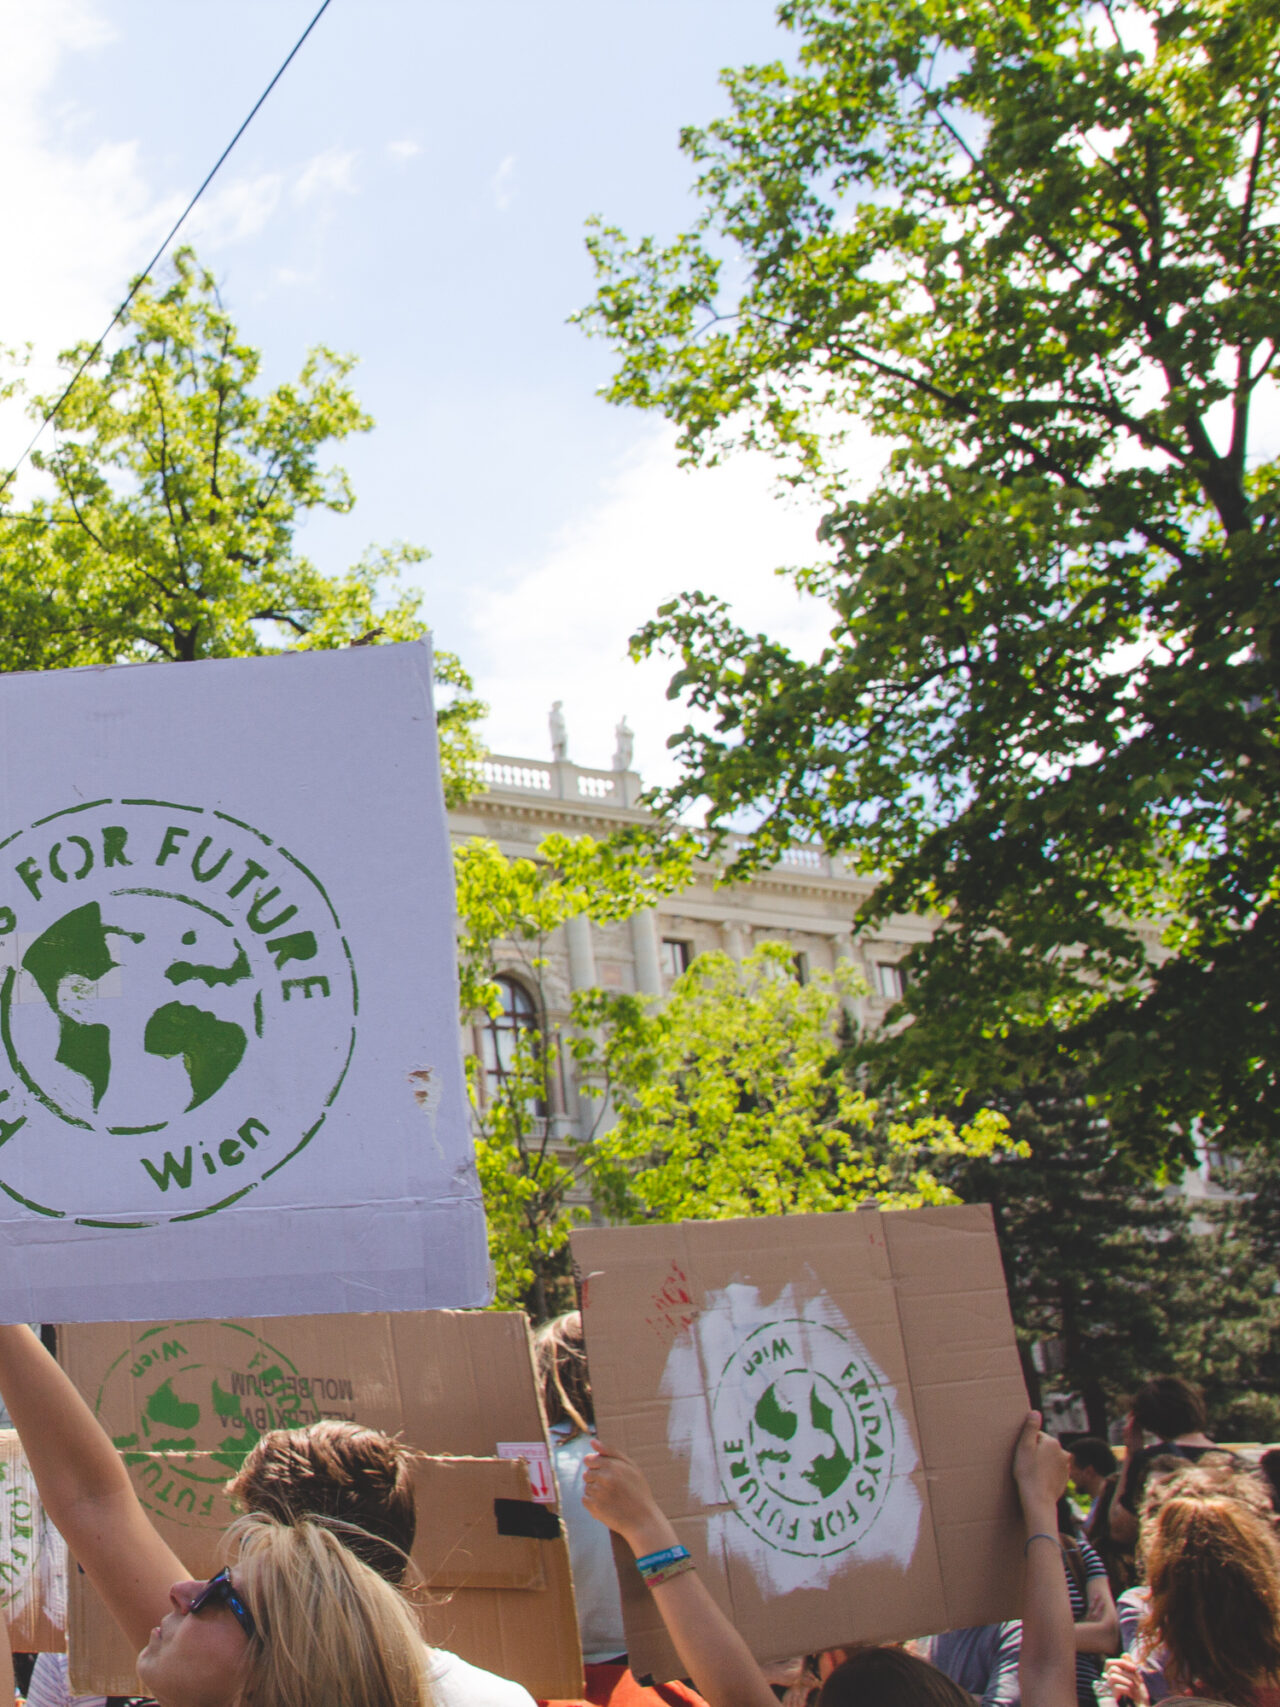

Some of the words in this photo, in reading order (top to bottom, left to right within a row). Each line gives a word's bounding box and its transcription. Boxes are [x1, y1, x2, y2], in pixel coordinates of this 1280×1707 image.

[14, 826, 133, 901] FOR
[155, 826, 331, 1002] FUTURE
[140, 1117, 270, 1192] Wien
[130, 1340, 188, 1377] Wien
[743, 1338, 794, 1376] Wien
[840, 1362, 885, 1502] FRIDAYS
[5, 1486, 33, 1539] FOR
[723, 1439, 800, 1541] FUTURE
[810, 1500, 860, 1542] FOR
